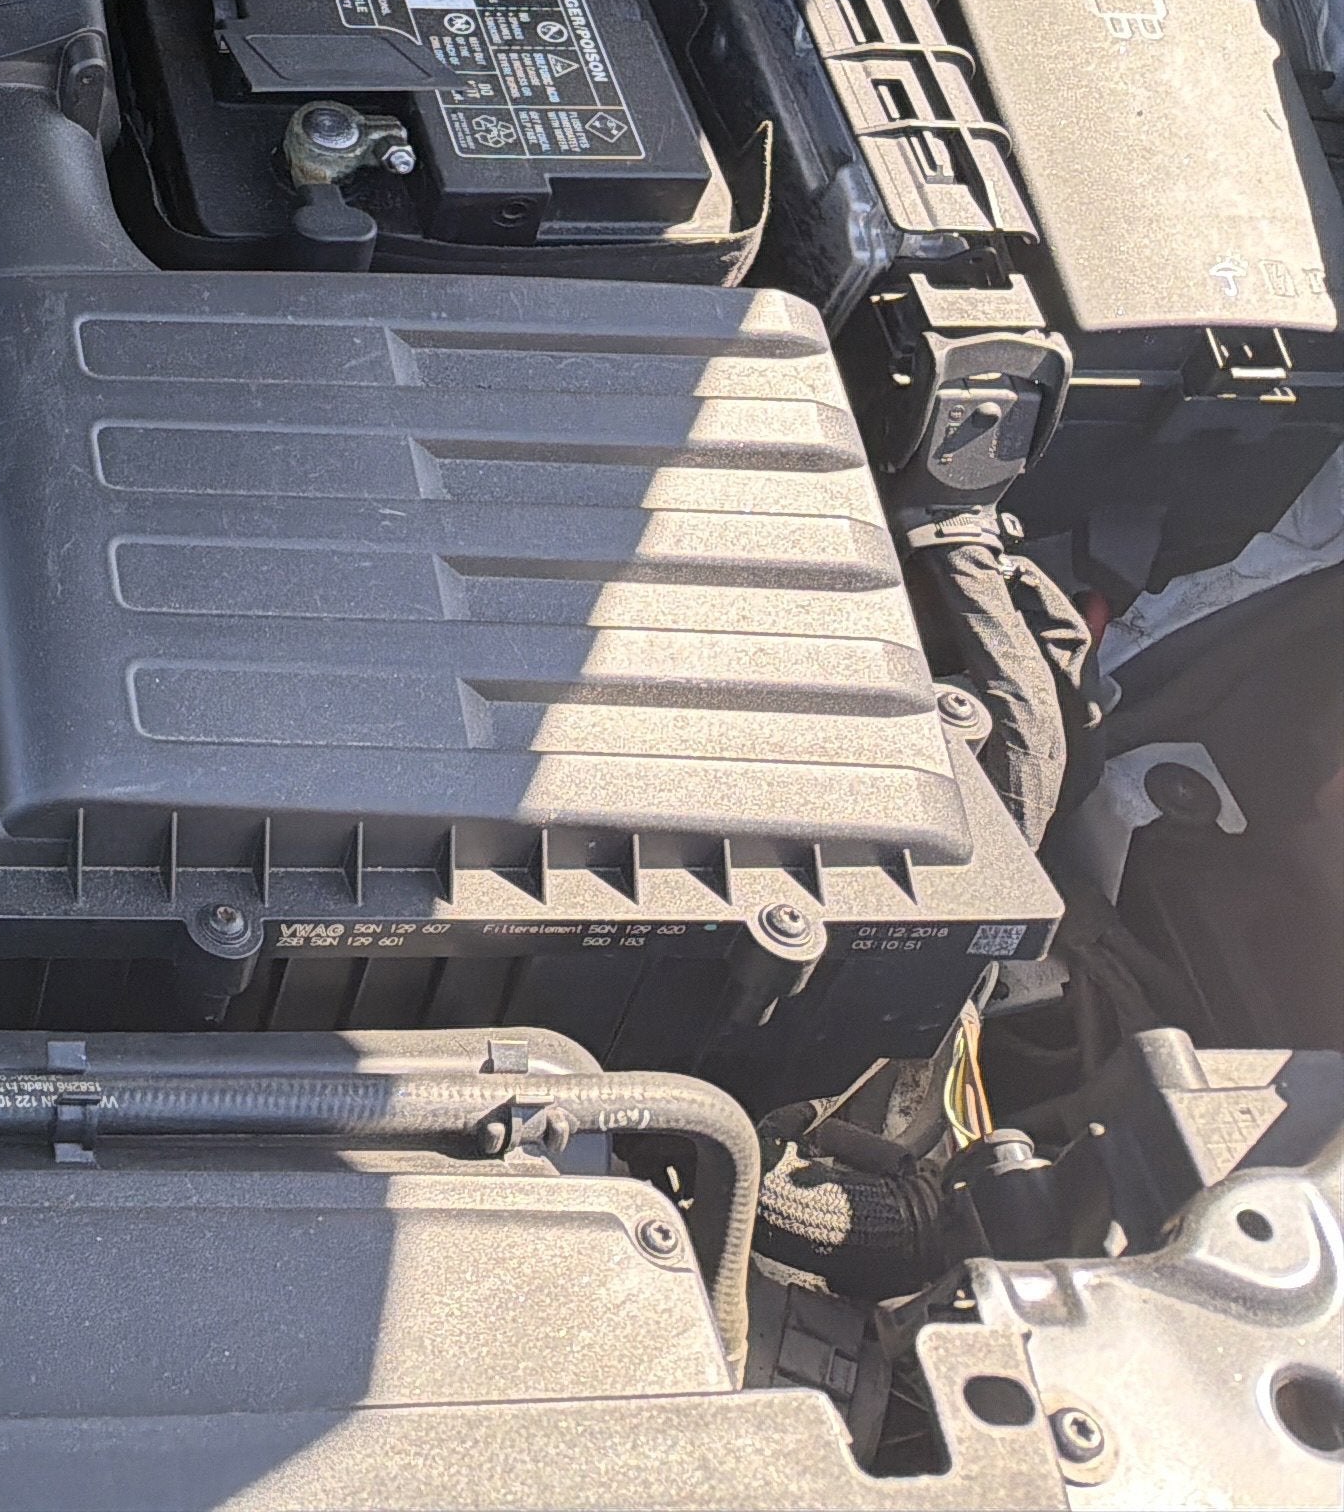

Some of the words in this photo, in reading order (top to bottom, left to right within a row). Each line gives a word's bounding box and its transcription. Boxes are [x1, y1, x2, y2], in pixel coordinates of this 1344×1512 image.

[353, 924, 382, 933] 5QN
[390, 924, 416, 933] 129
[422, 924, 452, 934] 607
[482, 924, 582, 934] Filterelement
[588, 924, 617, 933] 5QN
[624, 924, 651, 933] 129
[656, 924, 686, 934] 620
[310, 937, 338, 946] 5QN
[347, 936, 372, 945] 129
[378, 936, 403, 945] 601
[618, 937, 645, 946] 183
[18, 1081, 53, 1091] Made
[12, 1094, 35, 1106] 122
